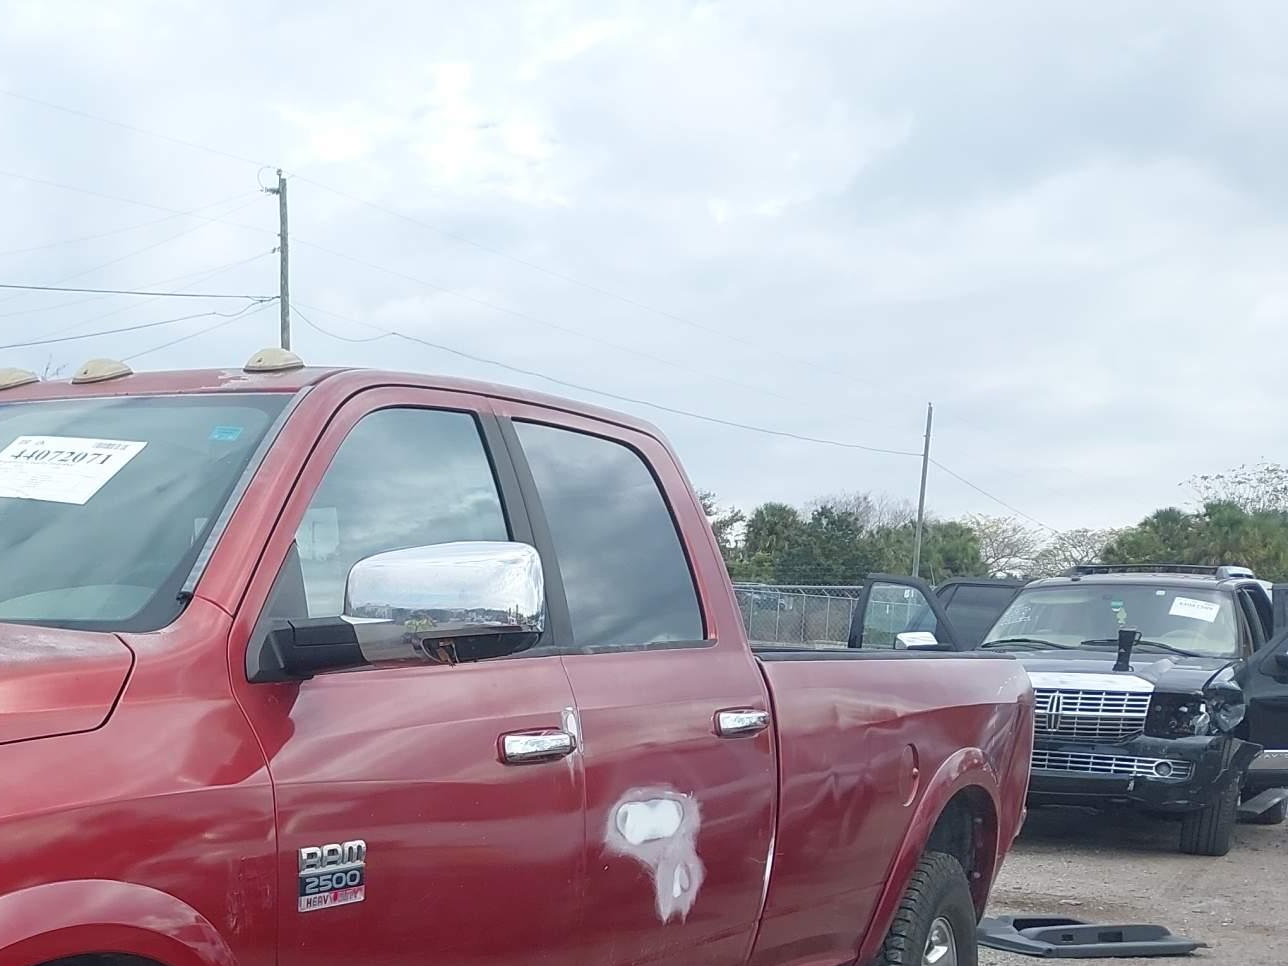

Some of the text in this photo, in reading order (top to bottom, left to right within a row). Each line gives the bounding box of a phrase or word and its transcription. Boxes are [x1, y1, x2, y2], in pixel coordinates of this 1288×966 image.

[11, 449, 113, 465] 44072071
[299, 839, 366, 873] RAM
[305, 870, 361, 894] 2500
